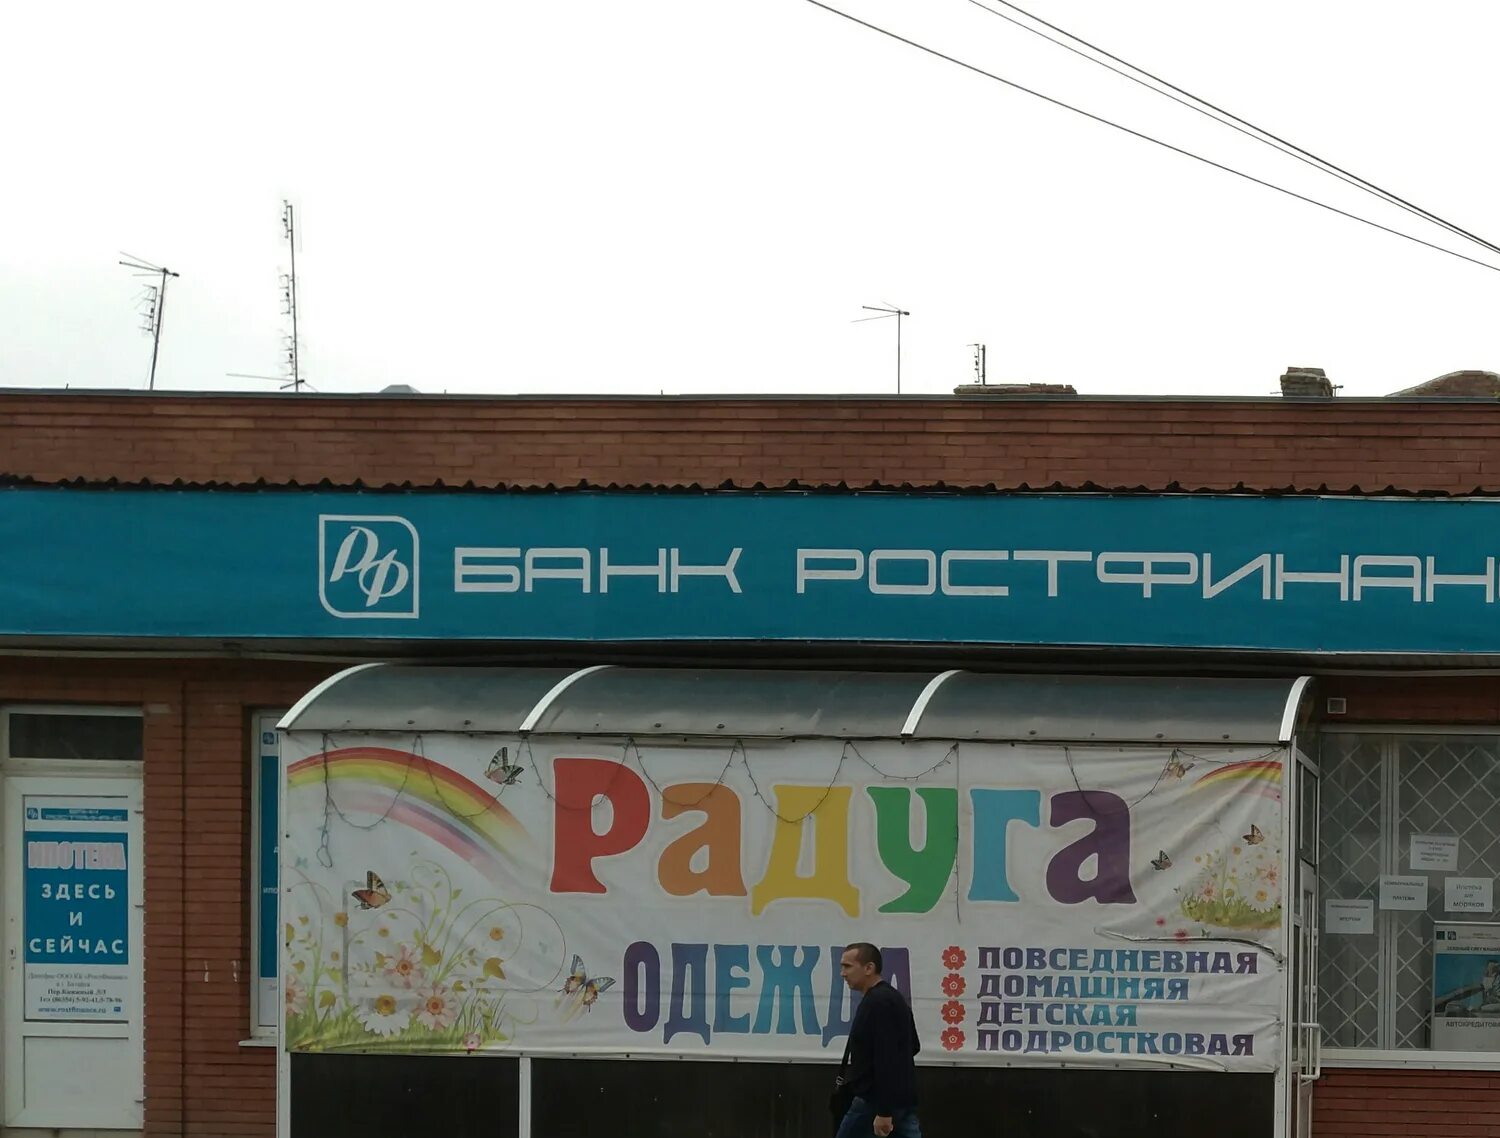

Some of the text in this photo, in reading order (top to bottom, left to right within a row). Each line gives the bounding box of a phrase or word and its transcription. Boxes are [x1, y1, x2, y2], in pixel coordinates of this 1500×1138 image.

[453, 546, 743, 594] БАНК
[549, 757, 1137, 918] Радуга
[41, 883, 116, 901] ЗДЕСЬ
[69, 911, 83, 926] И
[29, 935, 124, 954] СЕЙЧАС
[976, 946, 1258, 975] ПОВСЕДНЕВНАЯ
[976, 974, 1190, 1000] ДОМАШНЯЯ
[976, 1002, 1138, 1027] ДЕТСКАЯ
[976, 1029, 1256, 1056] ПОДРОСТКОВАЯ
